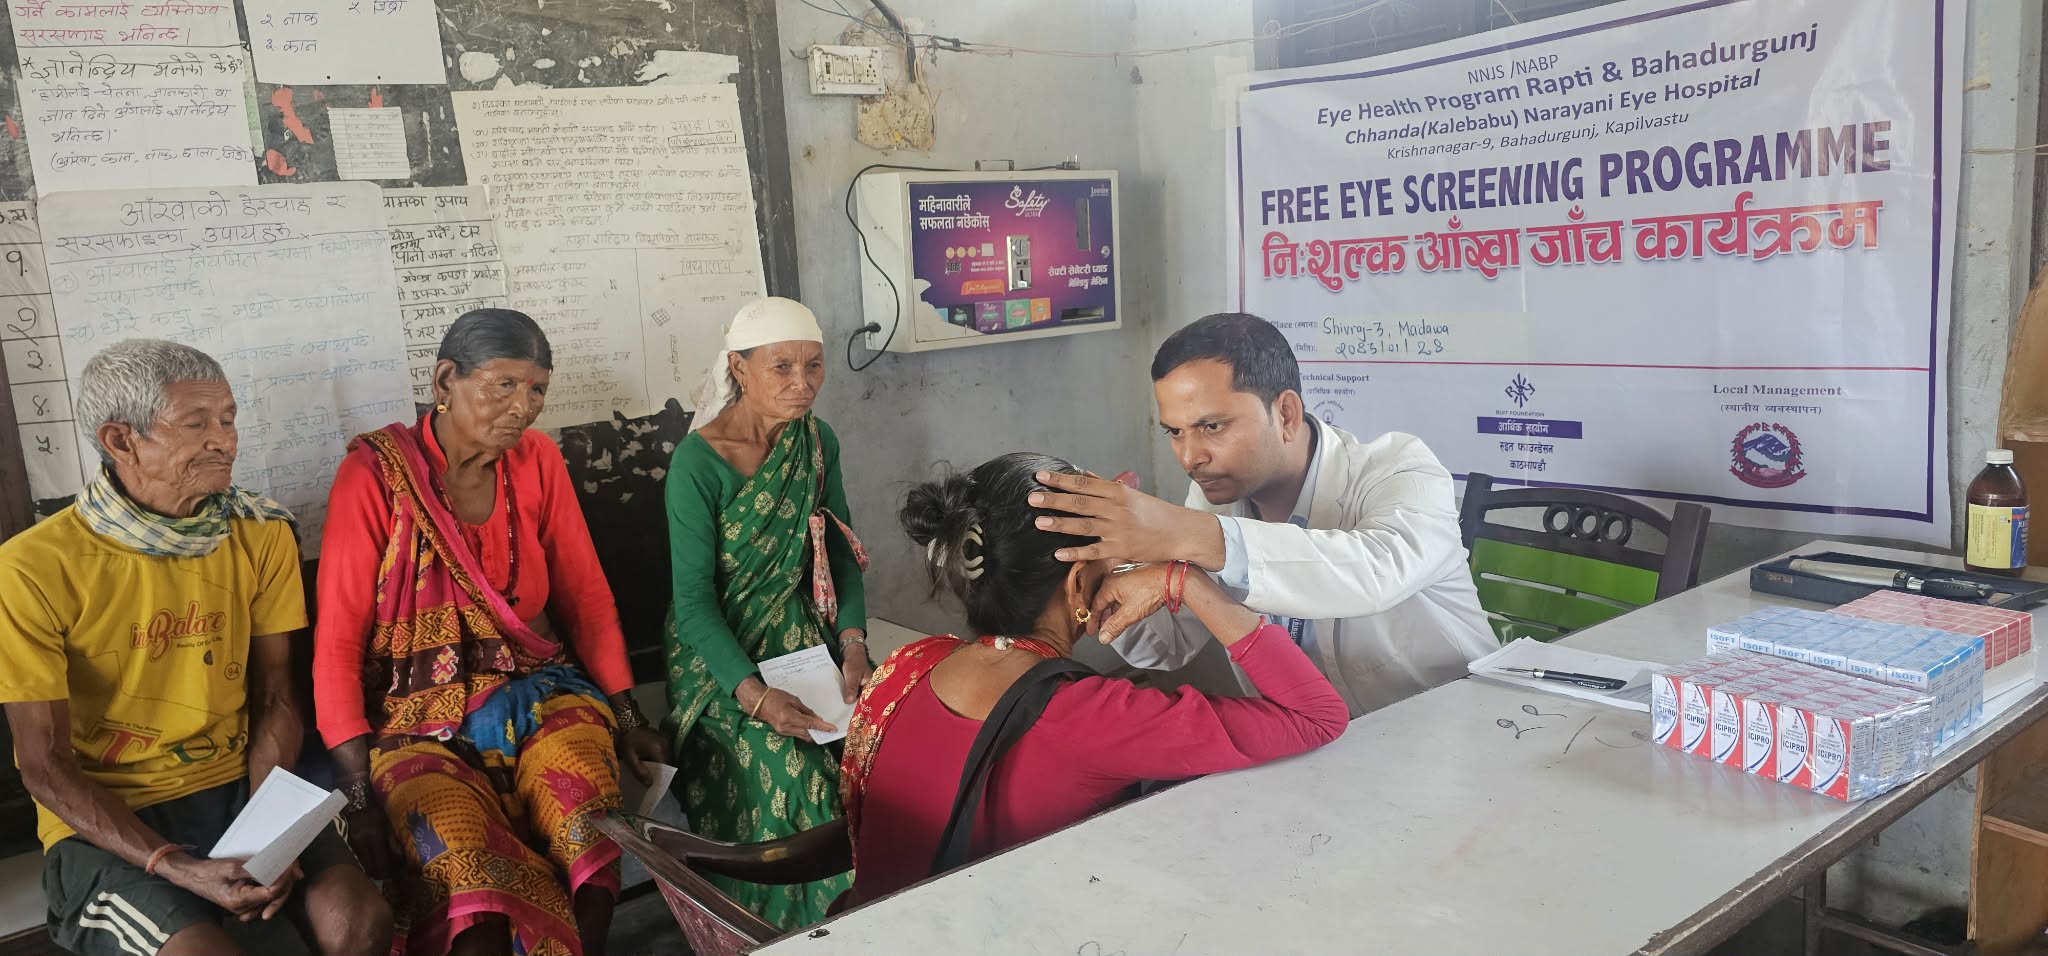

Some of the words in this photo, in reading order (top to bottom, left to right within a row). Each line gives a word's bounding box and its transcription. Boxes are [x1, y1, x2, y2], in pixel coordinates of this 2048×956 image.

[283, 12, 318, 26] नाक
[284, 39, 317, 53] कान
[1317, 106, 1352, 127] Eye
[1358, 97, 1422, 121] Health
[1425, 83, 1520, 112] Program
[1526, 65, 1593, 97] Rapti
[1602, 60, 1623, 83] &
[1631, 23, 1818, 78] Bahadurgunj
[1468, 64, 1505, 85] NNJS
[1345, 109, 1519, 145] Chhanda(Kalebabu)
[1523, 94, 1613, 124] Narayani
[1620, 90, 1657, 110] Eye
[1664, 68, 1761, 102] Hospital
[1387, 136, 1495, 160] Krishnanagar-9,
[1500, 124, 1599, 148] Bahadurgunj,
[1605, 112, 1690, 135] Kapilvastu
[1261, 184, 1330, 226] FREE
[1339, 178, 1394, 220] EYE
[1403, 157, 1584, 214] SCREENING
[1600, 120, 1891, 198] PROGRAMME
[918, 194, 971, 214] महिनावारीले
[1005, 186, 1049, 218] Safety
[919, 215, 955, 231] सफलता
[1414, 214, 1522, 280] आँखा
[1525, 204, 1624, 265] जाँच
[1630, 190, 1885, 262] कार्यक्रम
[1398, 318, 1449, 337] Madawa
[1336, 373, 1370, 384] Support
[1713, 384, 1748, 395] Local
[1752, 384, 1842, 398] Management
[1498, 419, 1523, 432] आर्थिक
[1525, 421, 1549, 435] सहयोग
[1710, 632, 1736, 644] ISOFT
[1743, 642, 1769, 653] ISOFT
[1778, 648, 1806, 660] ISOFT
[1813, 656, 1842, 668] ISOFT
[1850, 664, 1880, 677] ISOFT
[1891, 671, 1922, 683] ISOFT
[1656, 704, 1676, 718] CIPRO
[1684, 712, 1705, 725] ICIPRO
[1715, 722, 1737, 735] ICIPRO
[1783, 740, 1805, 753] ICIPRO
[1818, 748, 1842, 762] ICIPRO
